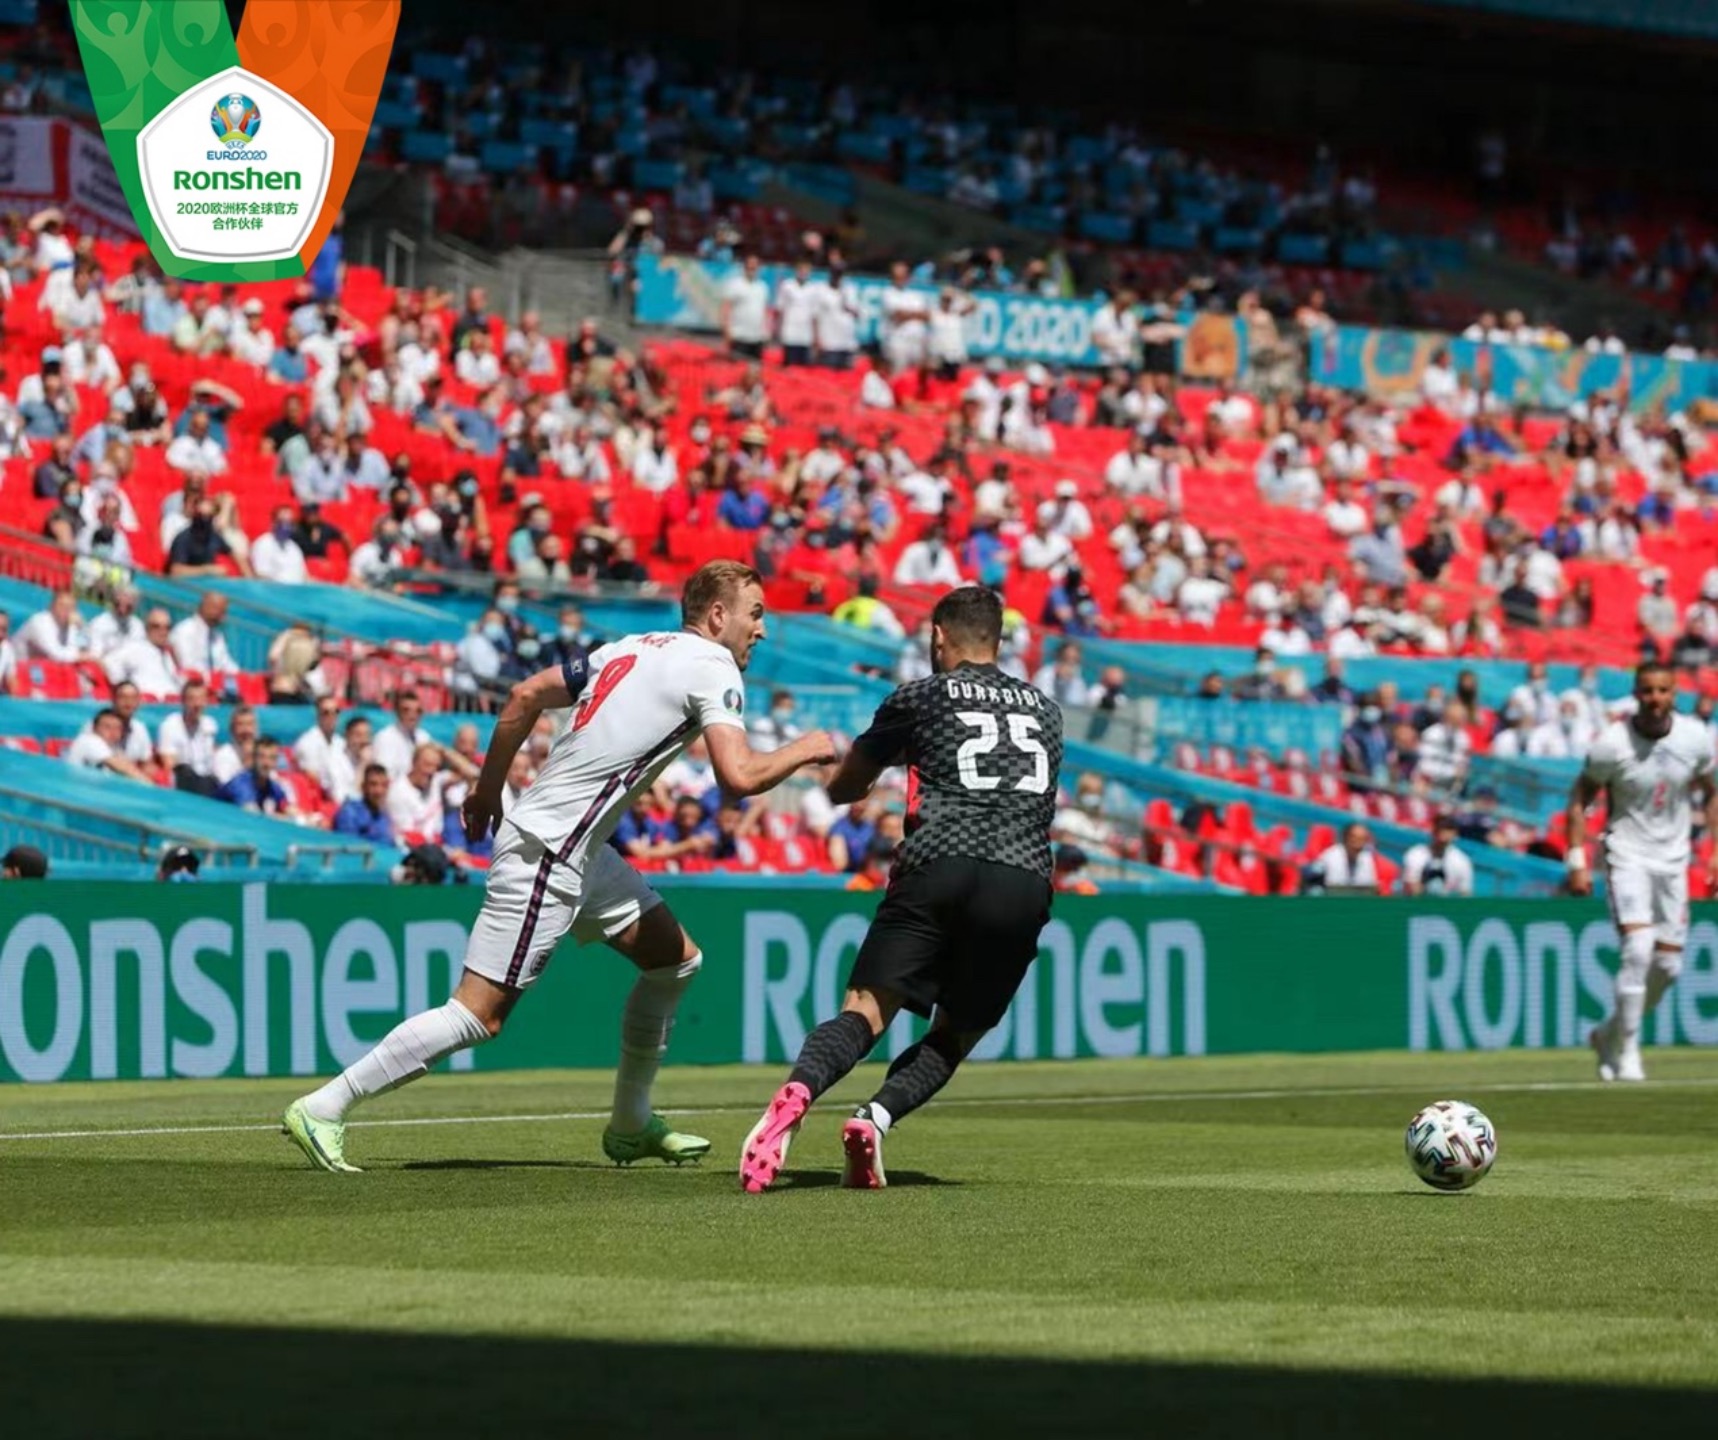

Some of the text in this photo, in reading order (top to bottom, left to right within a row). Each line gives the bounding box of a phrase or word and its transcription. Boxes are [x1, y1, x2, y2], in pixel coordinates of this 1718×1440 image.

[1004, 302, 1090, 354] 2020
[572, 654, 637, 732] 9
[955, 711, 1049, 794] 25
[1407, 915, 1718, 1052] Ronse
